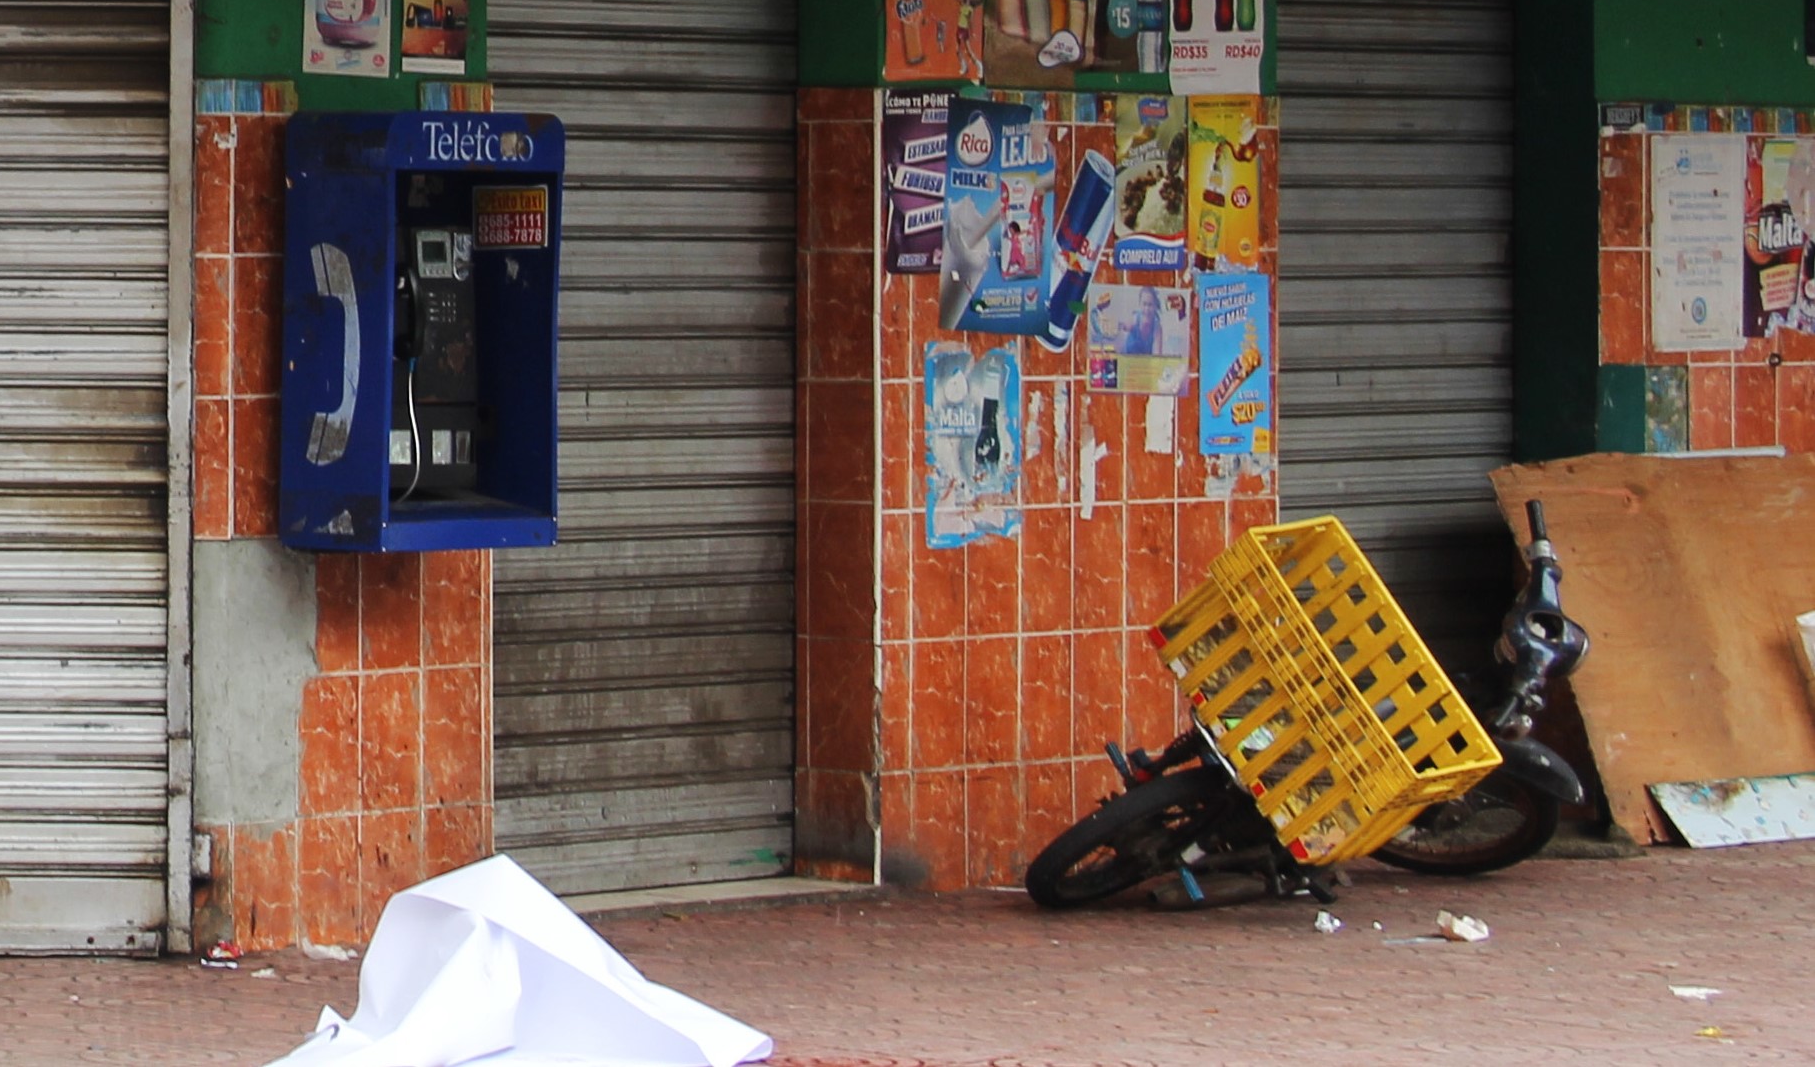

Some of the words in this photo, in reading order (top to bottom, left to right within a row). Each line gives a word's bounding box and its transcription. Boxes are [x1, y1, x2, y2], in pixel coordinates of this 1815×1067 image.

[1173, 44, 1208, 60] RD$35
[1225, 44, 1261, 59] RD$40
[923, 93, 949, 108] PONE
[422, 120, 534, 162] Teléfoo
[907, 137, 946, 160] ESTRESAD
[961, 133, 989, 153] Rica
[520, 190, 542, 208] taxi
[1760, 213, 1803, 250] Malta
[1211, 314, 1226, 332] DE
[940, 408, 975, 427] Malta
